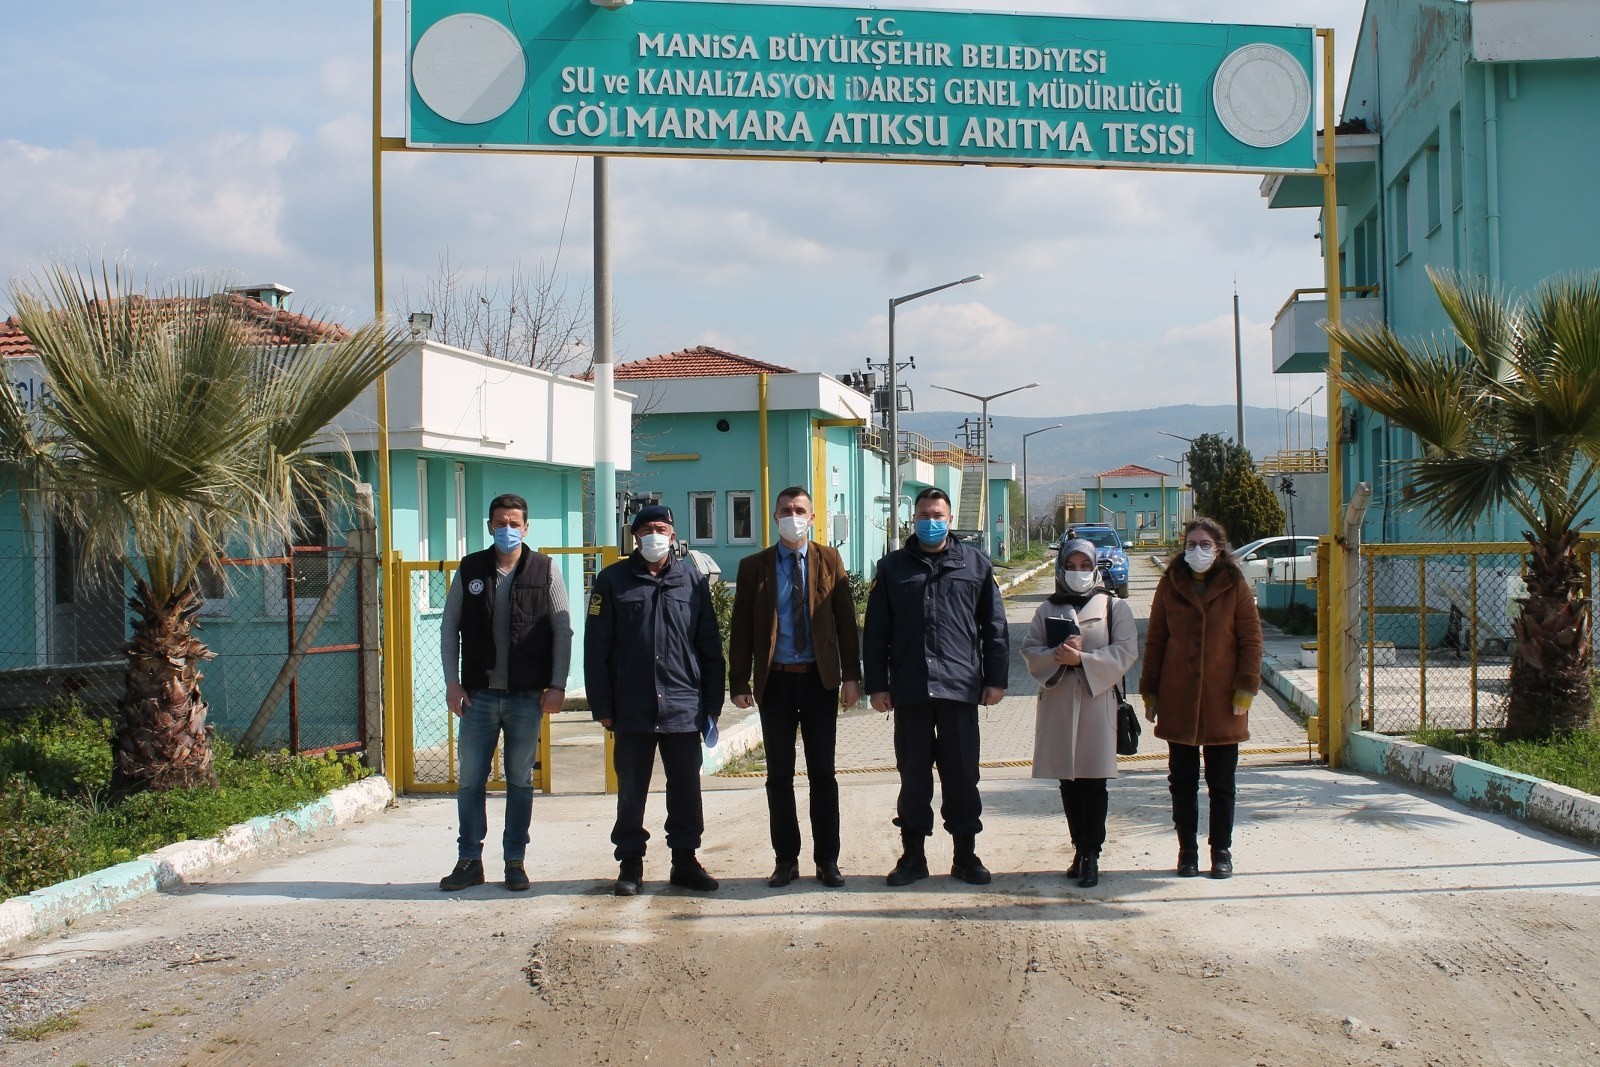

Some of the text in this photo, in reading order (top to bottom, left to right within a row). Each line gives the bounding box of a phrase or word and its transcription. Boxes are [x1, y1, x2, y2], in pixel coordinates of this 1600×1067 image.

[855, 16, 904, 36] T.C.
[561, 66, 595, 95] SU
[604, 74, 630, 95] ve
[944, 78, 1021, 107] GENEL
[1027, 77, 1182, 114] MÜDÜRLÜĞÜ
[548, 101, 814, 142] GÖLMARMARA
[824, 112, 949, 146] ATIKSU
[960, 117, 1092, 152] ARITMA
